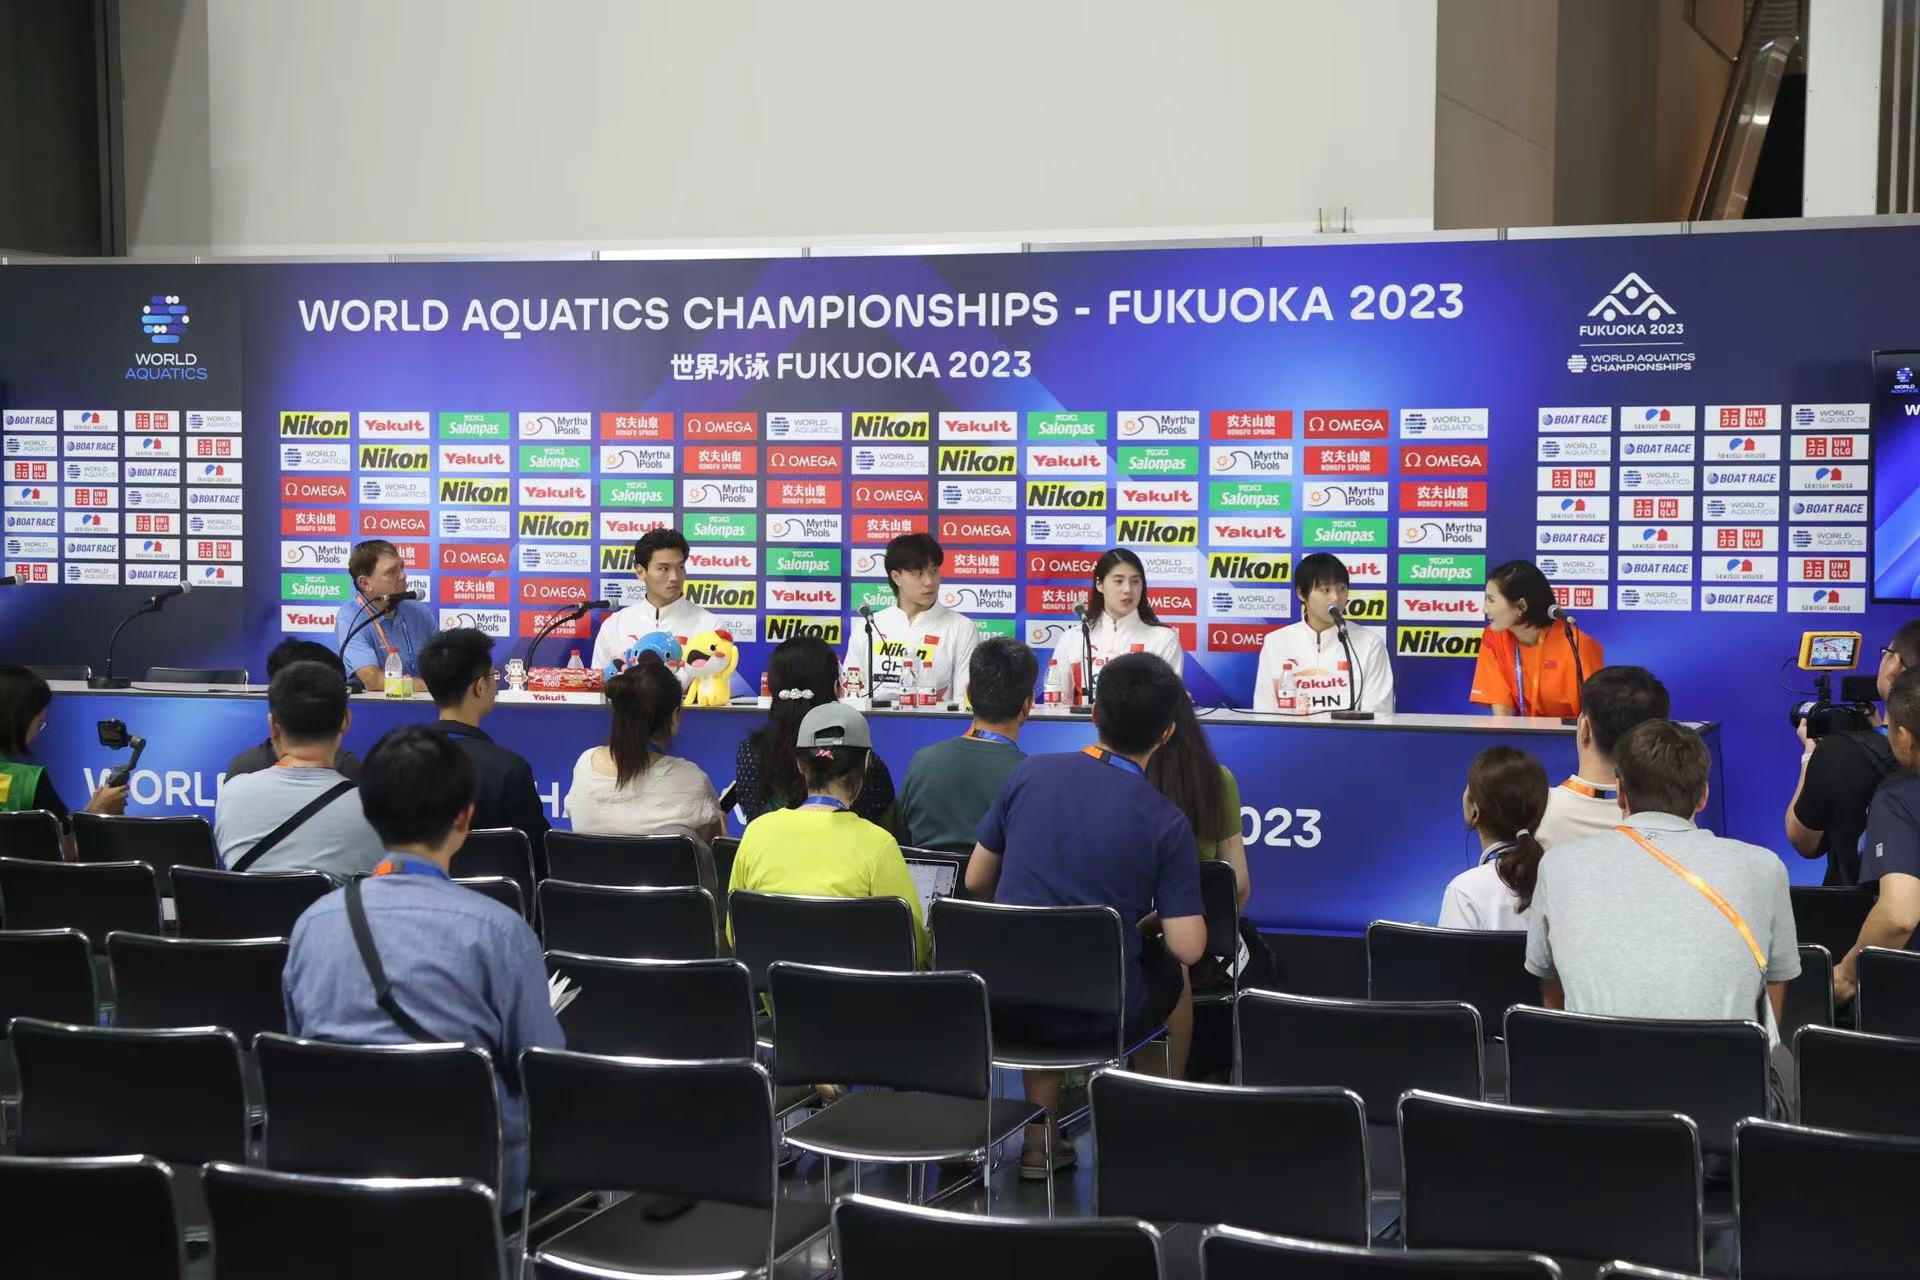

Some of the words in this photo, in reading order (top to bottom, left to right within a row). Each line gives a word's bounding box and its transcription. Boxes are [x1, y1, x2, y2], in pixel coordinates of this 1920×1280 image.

[299, 300, 448, 331] WORLD
[462, 298, 668, 339] AQUATICS
[684, 292, 1058, 330] CHAMPIONSHIPS
[1110, 286, 1334, 325] FUKUOKA
[1351, 283, 1464, 320] 2023
[1579, 325, 1646, 336] FUKUOKA
[1650, 324, 1684, 335] 2023
[136, 353, 197, 365] WORLD
[1591, 355, 1635, 363] WORLD
[1637, 353, 1696, 362] AQUATICS
[671, 353, 769, 380] 世界水泳
[778, 352, 940, 379] FUKUOKA
[949, 350, 1032, 378] 2023
[1591, 363, 1692, 372] CHAMPIONSHIPS
[125, 368, 208, 380] AQUATICS
[15, 416, 34, 424] BOAT
[35, 416, 54, 424] RACE
[281, 415, 348, 435] Nikon
[557, 416, 587, 426] Myrtha
[615, 416, 659, 428] 农夫山泉
[1161, 415, 1194, 425] Myrtha
[1226, 414, 1275, 427] 农夫山泉
[1328, 419, 1383, 431] OMEGA
[1554, 414, 1580, 424] BOAT
[1581, 414, 1607, 423] RACE
[363, 420, 424, 431] Yakult
[448, 422, 499, 436] Salonpas
[704, 421, 753, 432] OMEGA
[853, 415, 926, 436] Nikon
[944, 420, 1011, 432] Yakult
[1037, 422, 1095, 436] Salonpas
[1161, 426, 1186, 434] Pools
[75, 442, 95, 450] BOAT
[96, 442, 116, 450] RACE
[1635, 444, 1662, 453] BOAT
[1663, 443, 1690, 452] RACE
[360, 448, 428, 468] Nikon
[444, 453, 505, 464] Yakult
[639, 449, 670, 460] Myrtha
[698, 450, 741, 462] 农夫山泉
[788, 455, 837, 466] OMEGA
[939, 450, 1014, 471] Nikon
[1032, 455, 1101, 466] Yakult
[1254, 450, 1288, 461] Myrtha
[1320, 450, 1370, 463] 农夫山泉
[528, 455, 580, 469] Salonpas
[639, 460, 662, 468] Pools
[1128, 456, 1186, 471] Salonpas
[1254, 461, 1280, 469] Pools
[1425, 455, 1482, 467] OMEGA
[136, 468, 156, 476] BOAT
[157, 468, 177, 476] RACE
[1719, 473, 1747, 482] BOAT
[1748, 473, 1776, 482] RACE
[301, 485, 346, 496] OMEGA
[440, 481, 508, 502] Nikon
[524, 486, 586, 498] Yakult
[722, 483, 753, 494] Myrtha
[781, 484, 825, 496] 农夫山泉
[1348, 486, 1383, 496] Myrtha
[1417, 486, 1468, 499] 农夫山泉
[609, 489, 662, 503] Salonpas
[722, 494, 745, 502] Pools
[874, 489, 924, 501] OMEGA
[1028, 485, 1104, 506] Nikon
[1122, 490, 1192, 502] Yakult
[1220, 492, 1279, 507] Salonpas
[1348, 497, 1374, 505] Pools
[1805, 504, 1833, 513] BOAT
[1834, 503, 1863, 512] RACE
[295, 512, 335, 524] 农夫山泉
[380, 518, 427, 529] OMEGA
[806, 518, 837, 528] Myrtha
[520, 515, 589, 536] Nikon
[693, 523, 745, 538] Salonpas
[866, 518, 912, 531] 农夫山泉
[960, 524, 1011, 536] OMEGA
[1446, 522, 1482, 533] Myrtha
[1117, 520, 1195, 542] Nikon
[1215, 526, 1285, 538] Yakult
[1314, 528, 1375, 543] Salonpas
[1446, 534, 1473, 542] Pools
[318, 545, 347, 554] Myrtha
[460, 552, 505, 563] OMEGA
[953, 554, 998, 566] 农夫山泉
[776, 558, 830, 572] Salonpas
[1211, 556, 1288, 578] Nikon
[1410, 565, 1473, 581] Salonpas
[290, 582, 340, 596] Salonpas
[454, 580, 495, 592] 农夫山泉
[540, 586, 586, 597] OMEGA
[771, 590, 836, 601] Yakult
[978, 588, 1011, 599] Myrtha
[1041, 589, 1087, 602] 农夫山泉
[978, 599, 1003, 607] Pools
[1146, 597, 1192, 608] MEGA
[1404, 600, 1480, 612] Yakult
[287, 613, 336, 625] Yakul
[477, 613, 506, 623] Myrtha
[880, 643, 927, 660] Nikn
[532, 694, 567, 702] Yakult
[1240, 806, 1322, 848] 023
